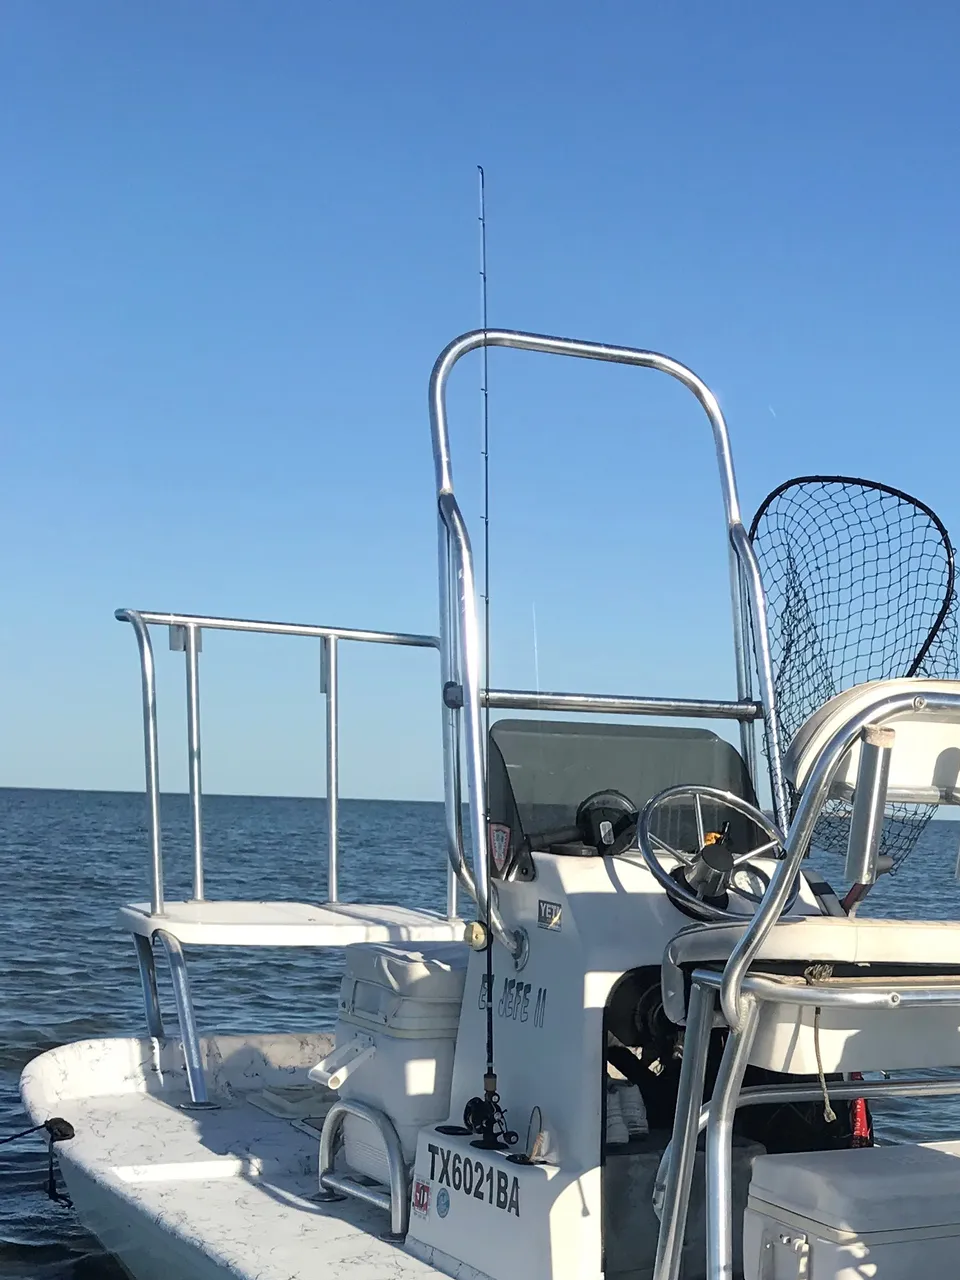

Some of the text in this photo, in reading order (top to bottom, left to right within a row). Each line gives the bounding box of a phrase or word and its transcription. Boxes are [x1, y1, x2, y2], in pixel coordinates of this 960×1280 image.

[478, 973, 495, 1010] E
[498, 977, 532, 1022] JEFE
[428, 1143, 520, 1217] TX6021BA
